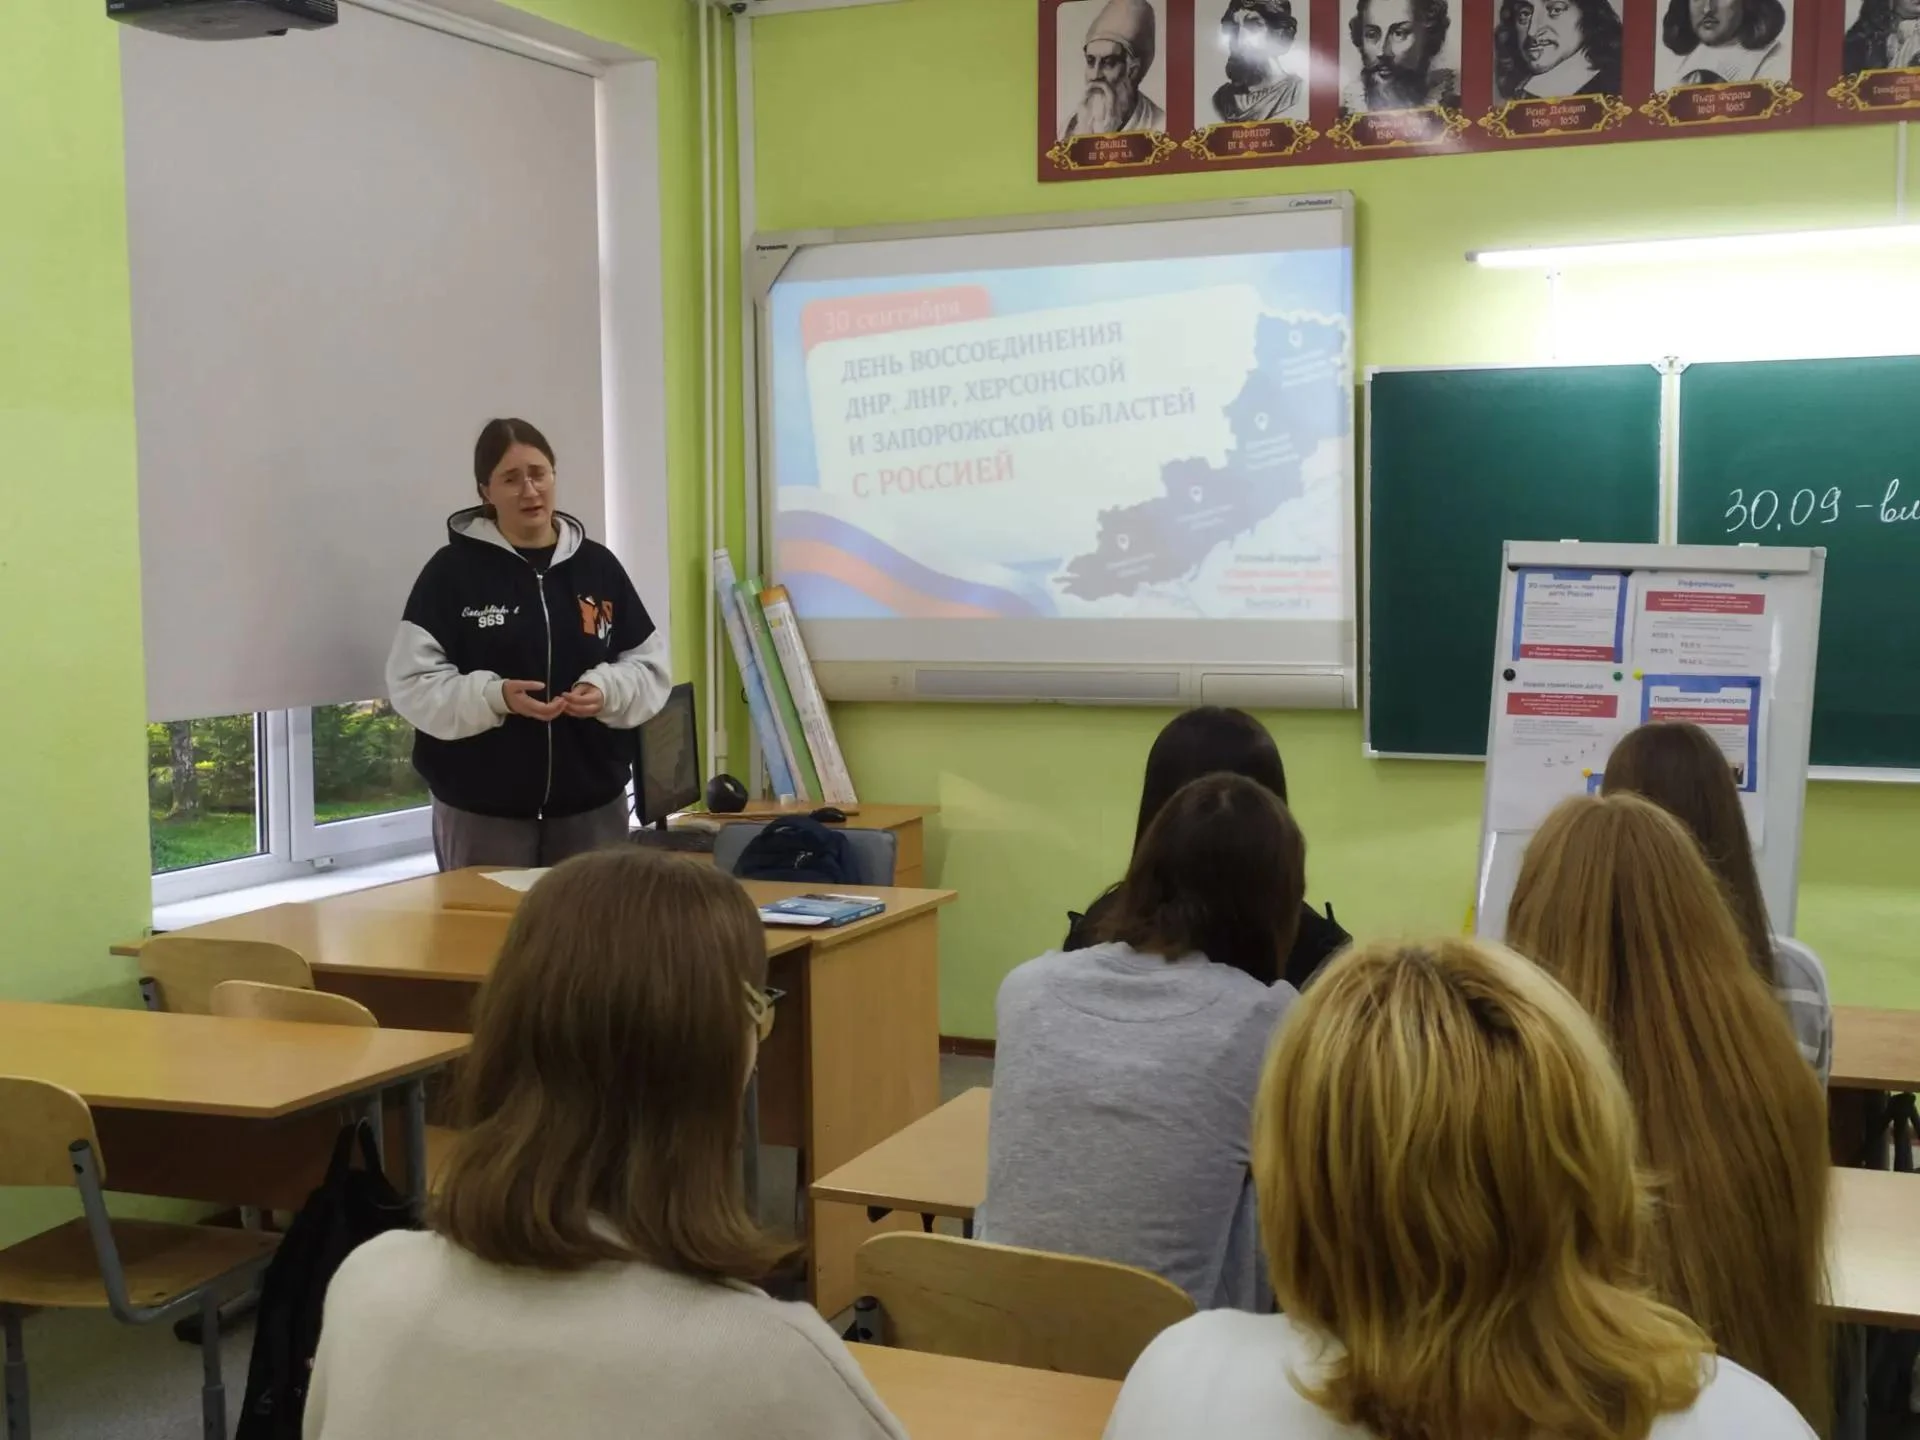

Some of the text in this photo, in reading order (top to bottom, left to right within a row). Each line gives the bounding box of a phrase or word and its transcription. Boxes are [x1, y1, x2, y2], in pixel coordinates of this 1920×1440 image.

[824, 300, 960, 335] 30 сентября
[840, 321, 1123, 385] ДЕНЬ ВОССОЕДИНЕНИЯ
[964, 357, 1126, 404] ХЕРСОНСКОЙ
[848, 386, 1196, 457] И ЗАПОРОЖСКОЙ ОБЛАСТЕЙ
[852, 449, 1015, 499] С РОССИЕЙ
[1724, 486, 1842, 533] 30.09
[478, 613, 505, 628] 969
